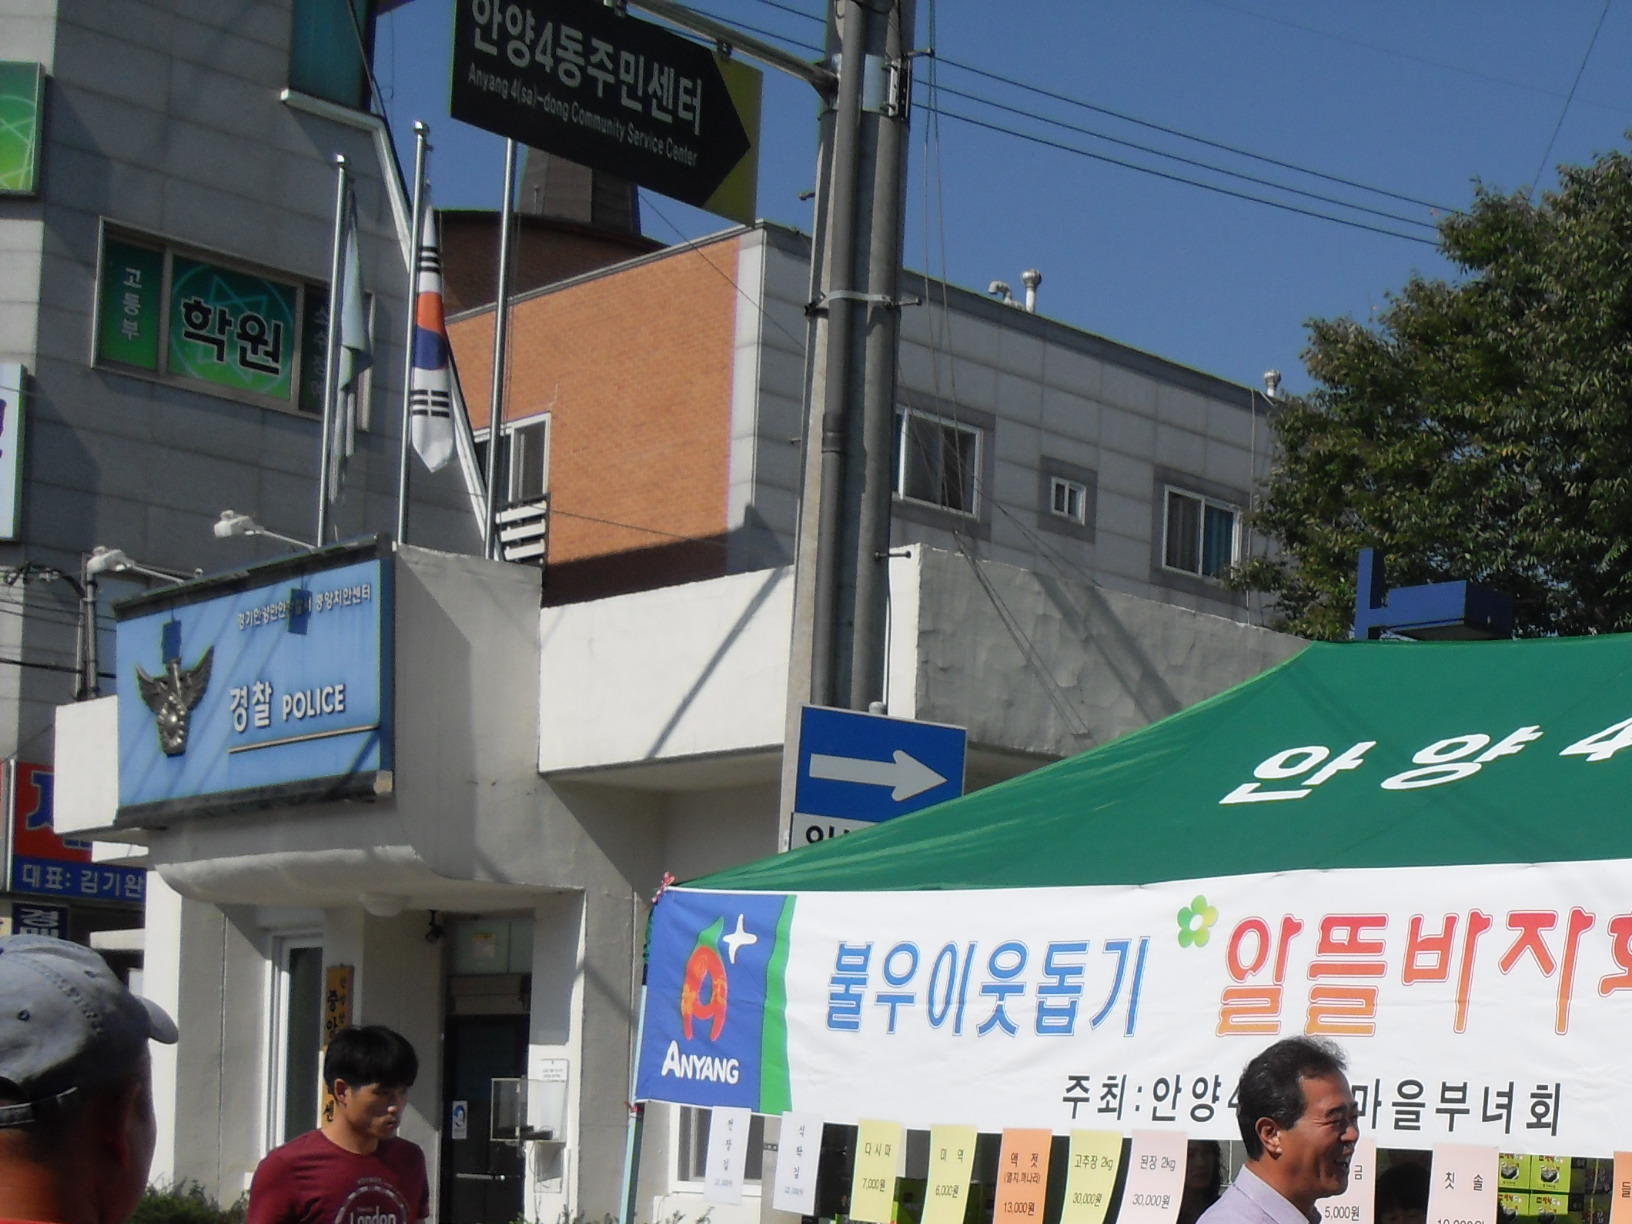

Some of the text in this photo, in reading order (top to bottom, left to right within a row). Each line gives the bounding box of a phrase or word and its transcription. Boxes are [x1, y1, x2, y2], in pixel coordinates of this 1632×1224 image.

[472, 0, 702, 136] 안양4동주민센터
[468, 62, 509, 99] Anyang
[571, 100, 626, 142] Community
[627, 121, 665, 155] Service
[666, 138, 698, 168] Center
[182, 297, 284, 377] 학원
[230, 680, 346, 733] 경찰 POLICE
[826, 936, 1151, 1038] 불우이웃돕기
[1073, 1153, 1114, 1172] 고추장 2kg
[1140, 1154, 1176, 1172] 된장 2kg
[862, 1177, 887, 1193] 7,000원
[935, 1184, 960, 1199] 6,000원
[1003, 1200, 1036, 1216] 13,000원
[1072, 1192, 1103, 1208] 30,000원
[1132, 1193, 1171, 1210] 30,000원
[1324, 1205, 1360, 1222] 5,000원
